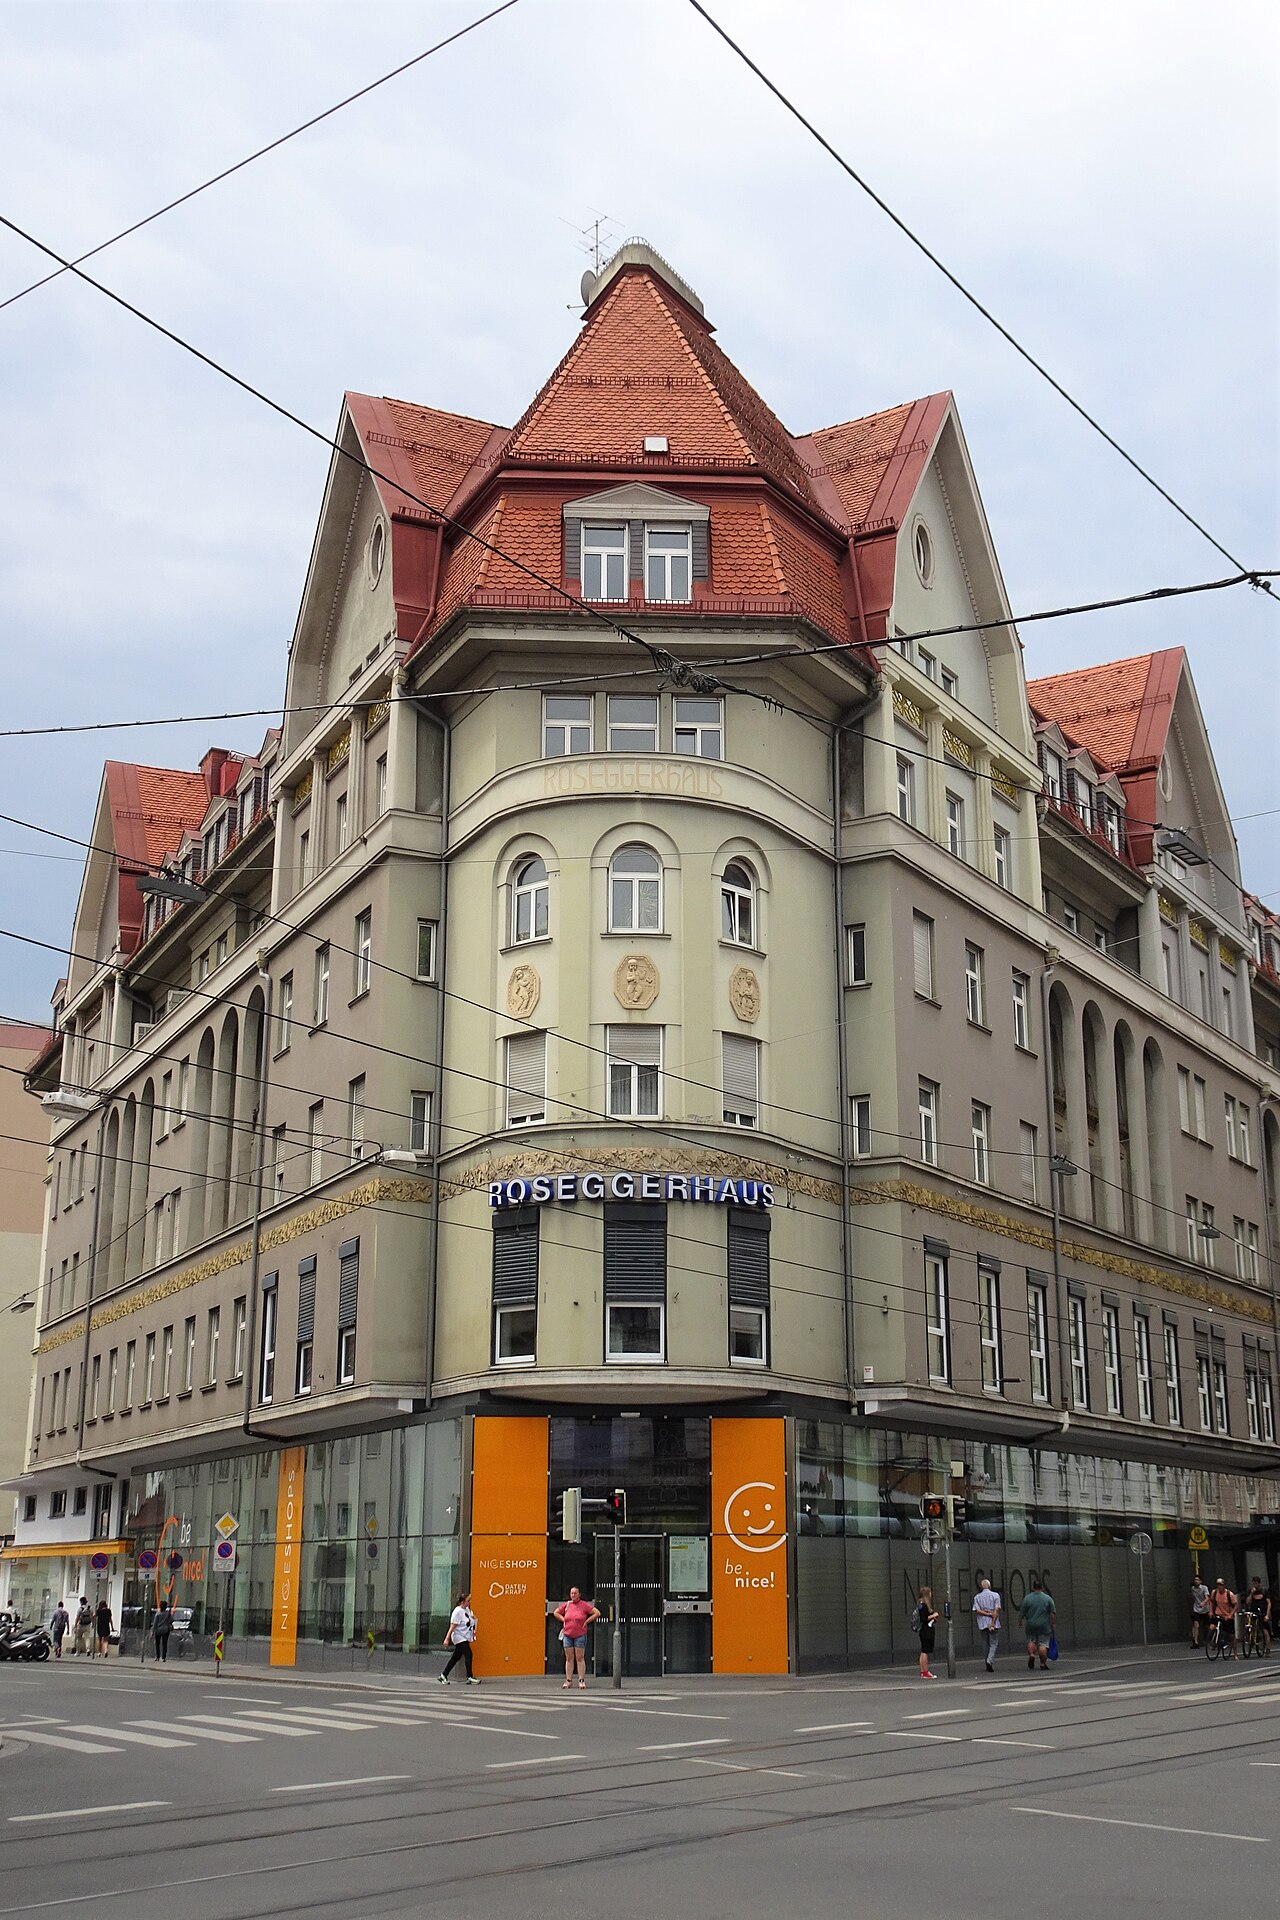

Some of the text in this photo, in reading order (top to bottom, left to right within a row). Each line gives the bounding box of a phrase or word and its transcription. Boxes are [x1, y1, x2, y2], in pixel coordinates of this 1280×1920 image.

[544, 760, 724, 797] ROSEGGERHAUS
[488, 1172, 775, 1208] ROSEGGERHAUS
[181, 1512, 191, 1543] be
[183, 1547, 205, 1581] nice!
[479, 1559, 538, 1569] NICESHOPS
[725, 1558, 743, 1575] be
[735, 1571, 775, 1588] nice!
